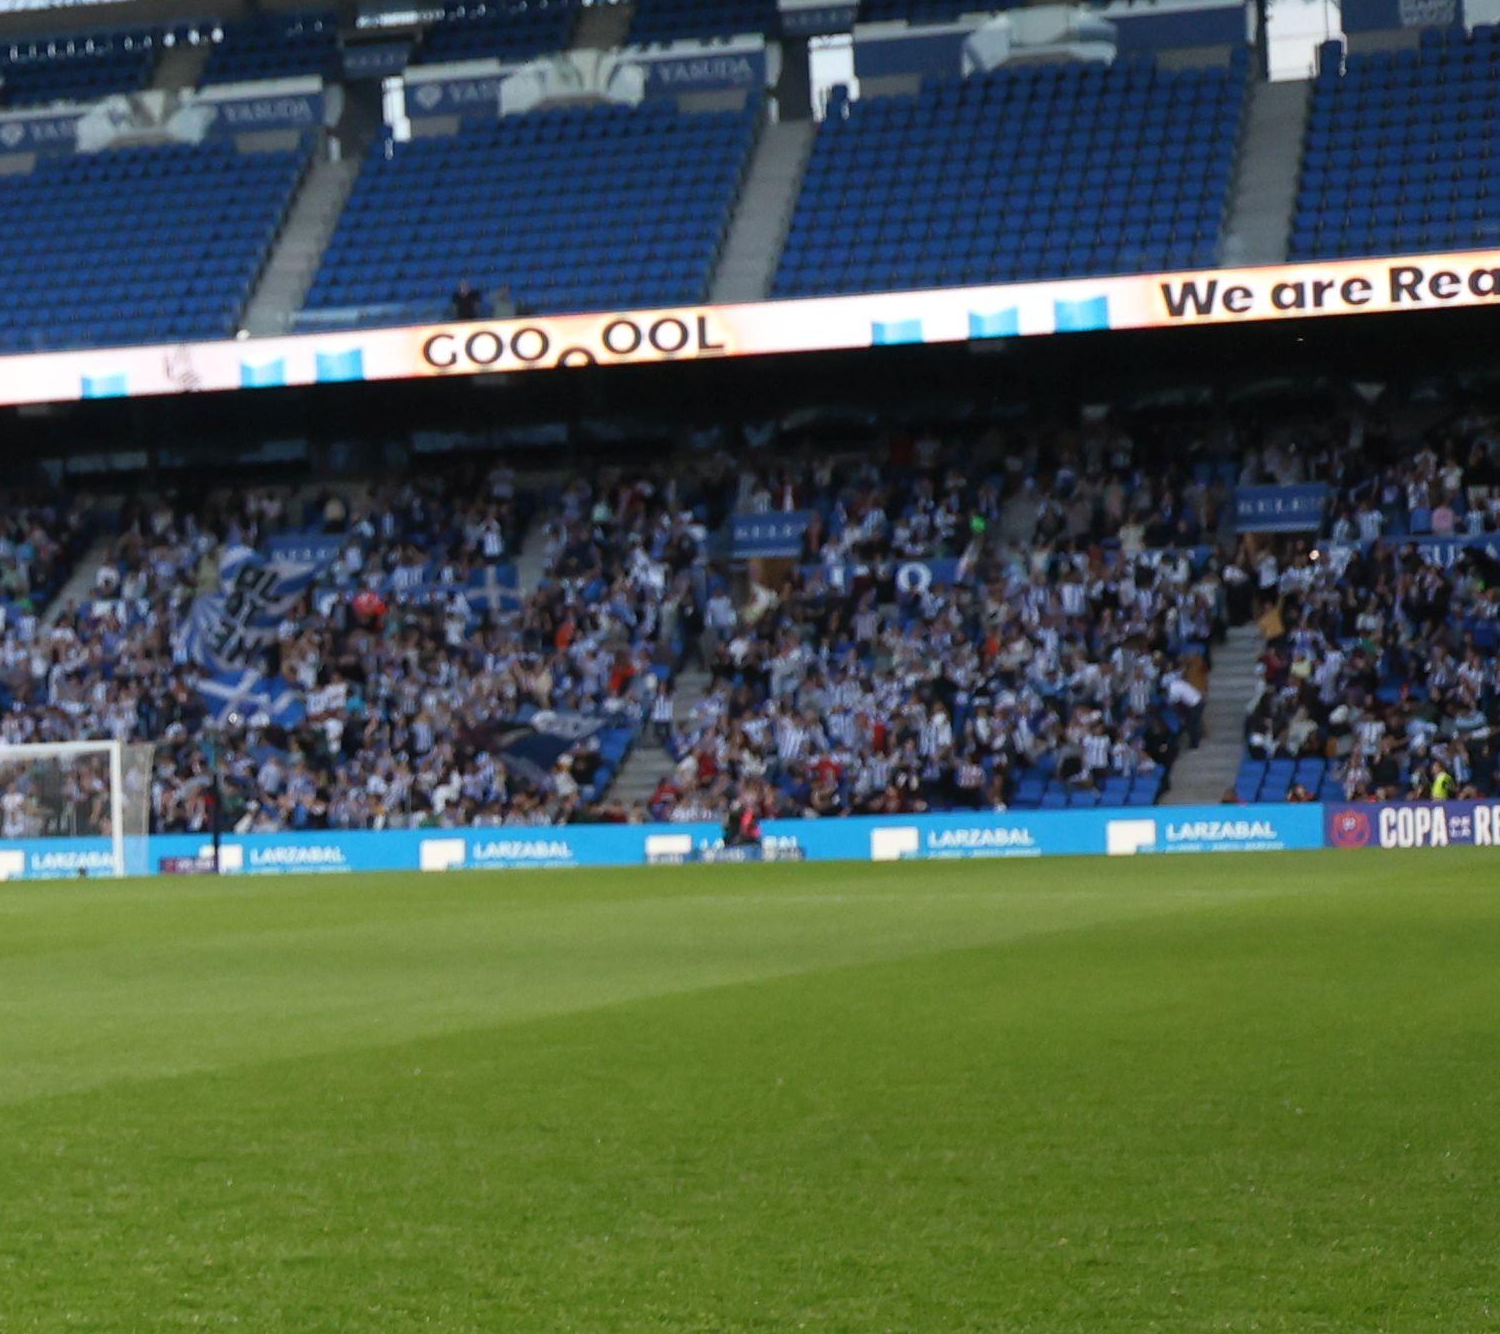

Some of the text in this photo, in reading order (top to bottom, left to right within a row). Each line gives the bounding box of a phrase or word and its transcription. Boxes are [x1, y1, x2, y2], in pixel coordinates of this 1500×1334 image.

[1161, 279, 1254, 317] We
[1271, 276, 1373, 310] are
[1166, 820, 1277, 841] LARZABAL
[1380, 806, 1449, 849] COPA
[928, 828, 1034, 849] LARZABAL
[31, 850, 114, 869] LARZABA
[250, 846, 347, 865] LARZABAL
[473, 840, 573, 859] LARZABAL
